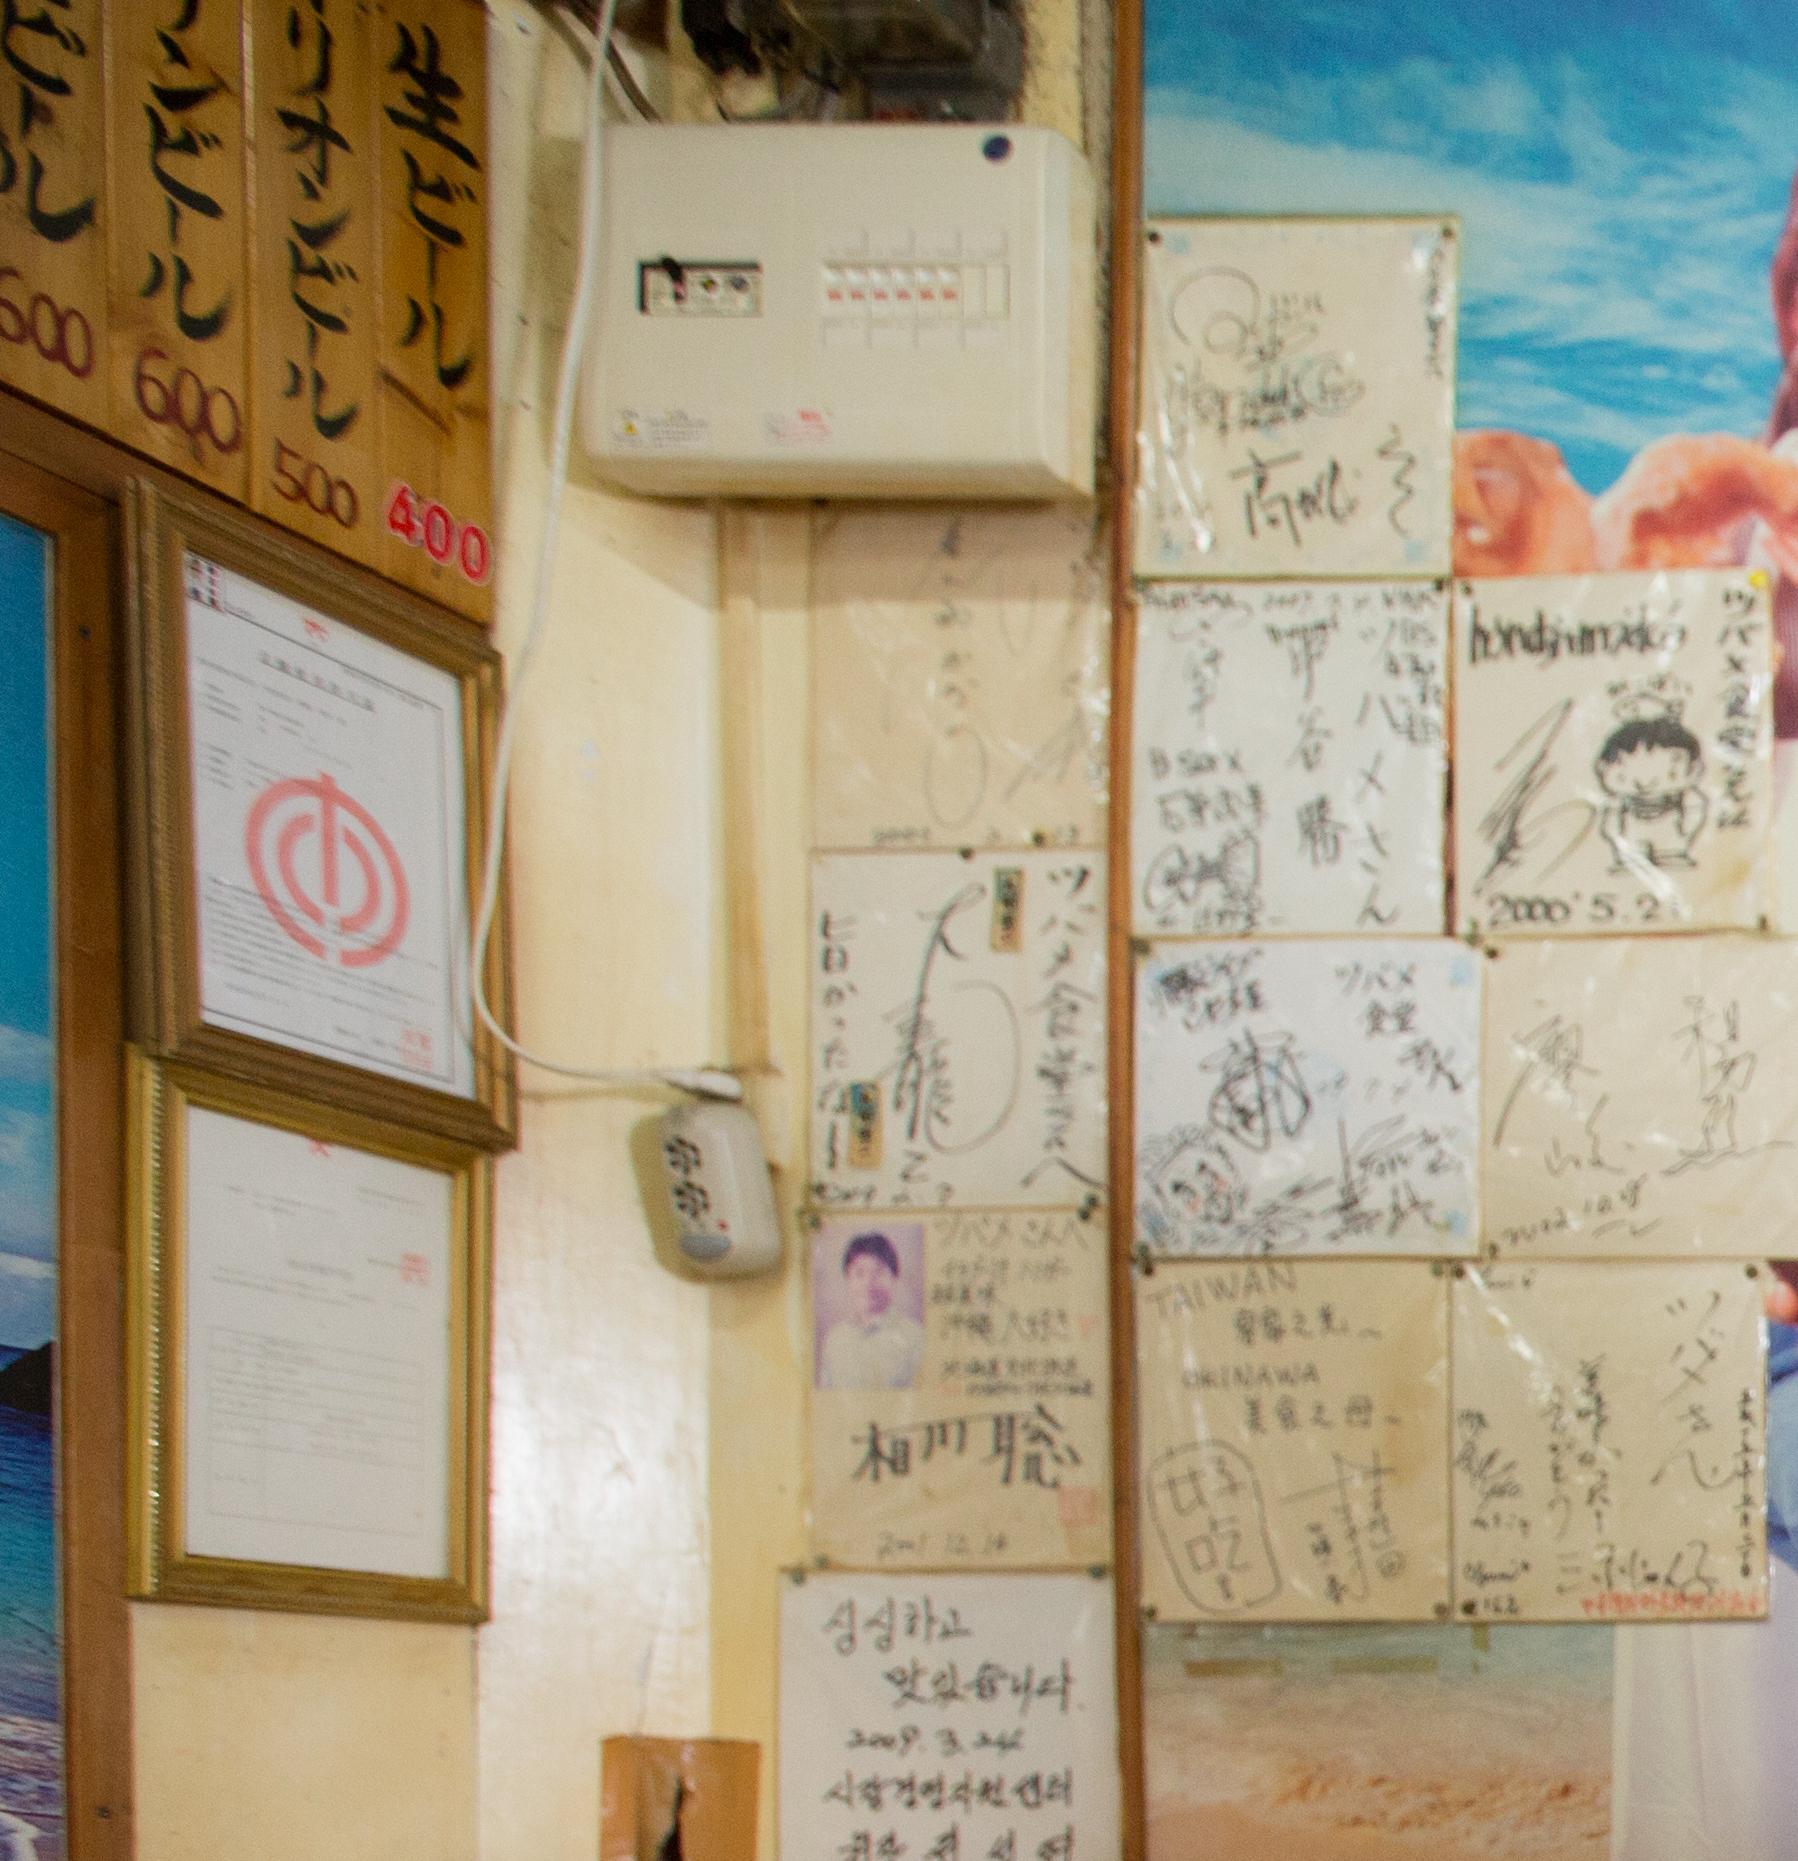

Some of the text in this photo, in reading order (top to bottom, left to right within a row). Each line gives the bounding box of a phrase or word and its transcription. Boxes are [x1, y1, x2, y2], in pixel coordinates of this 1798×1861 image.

[384, 20, 482, 390] 生ビール
[134, 346, 242, 454] 600
[272, 437, 360, 528] 500
[386, 482, 490, 586] 400
[1149, 1262, 1300, 1320] TAIWAN
[1181, 1360, 1321, 1389] OKINAWA
